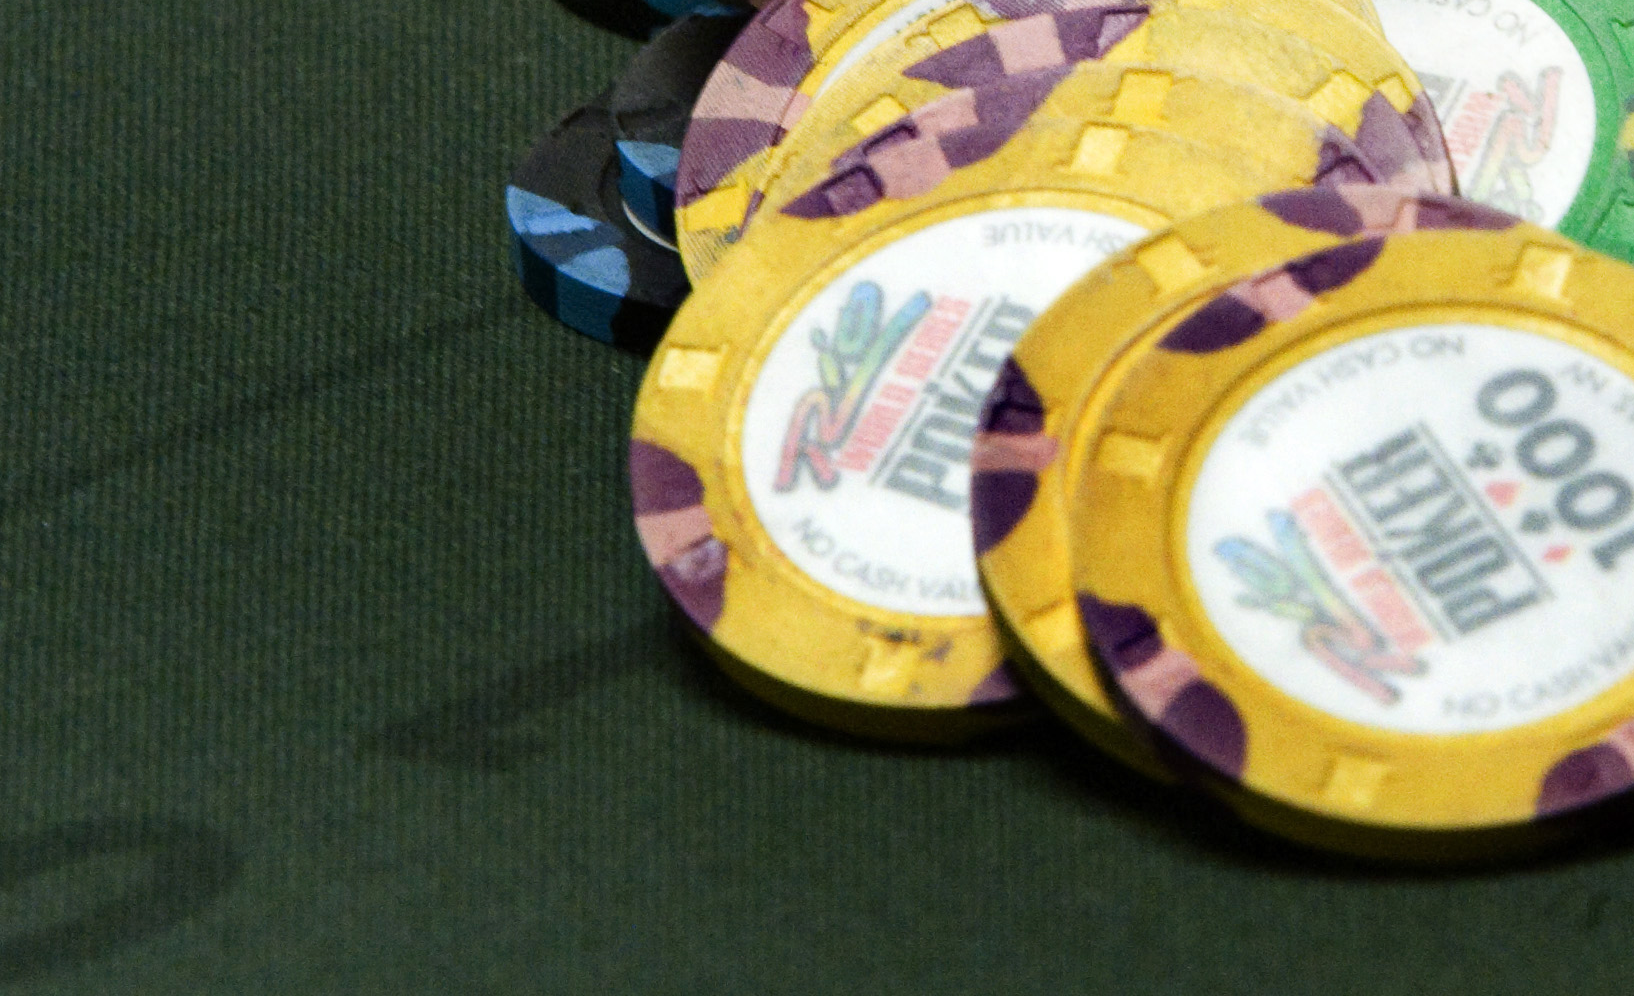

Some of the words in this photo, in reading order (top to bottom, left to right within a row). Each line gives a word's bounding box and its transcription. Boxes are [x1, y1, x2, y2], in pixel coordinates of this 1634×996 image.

[981, 220, 1078, 249] VALUE
[1318, 339, 1405, 386] CASH
[1410, 333, 1467, 364] NO
[1239, 381, 1316, 448] VALUE
[1337, 424, 1550, 637] POKER
[795, 516, 836, 562] NO
[834, 547, 912, 599] CASH
[916, 577, 974, 604] VAL
